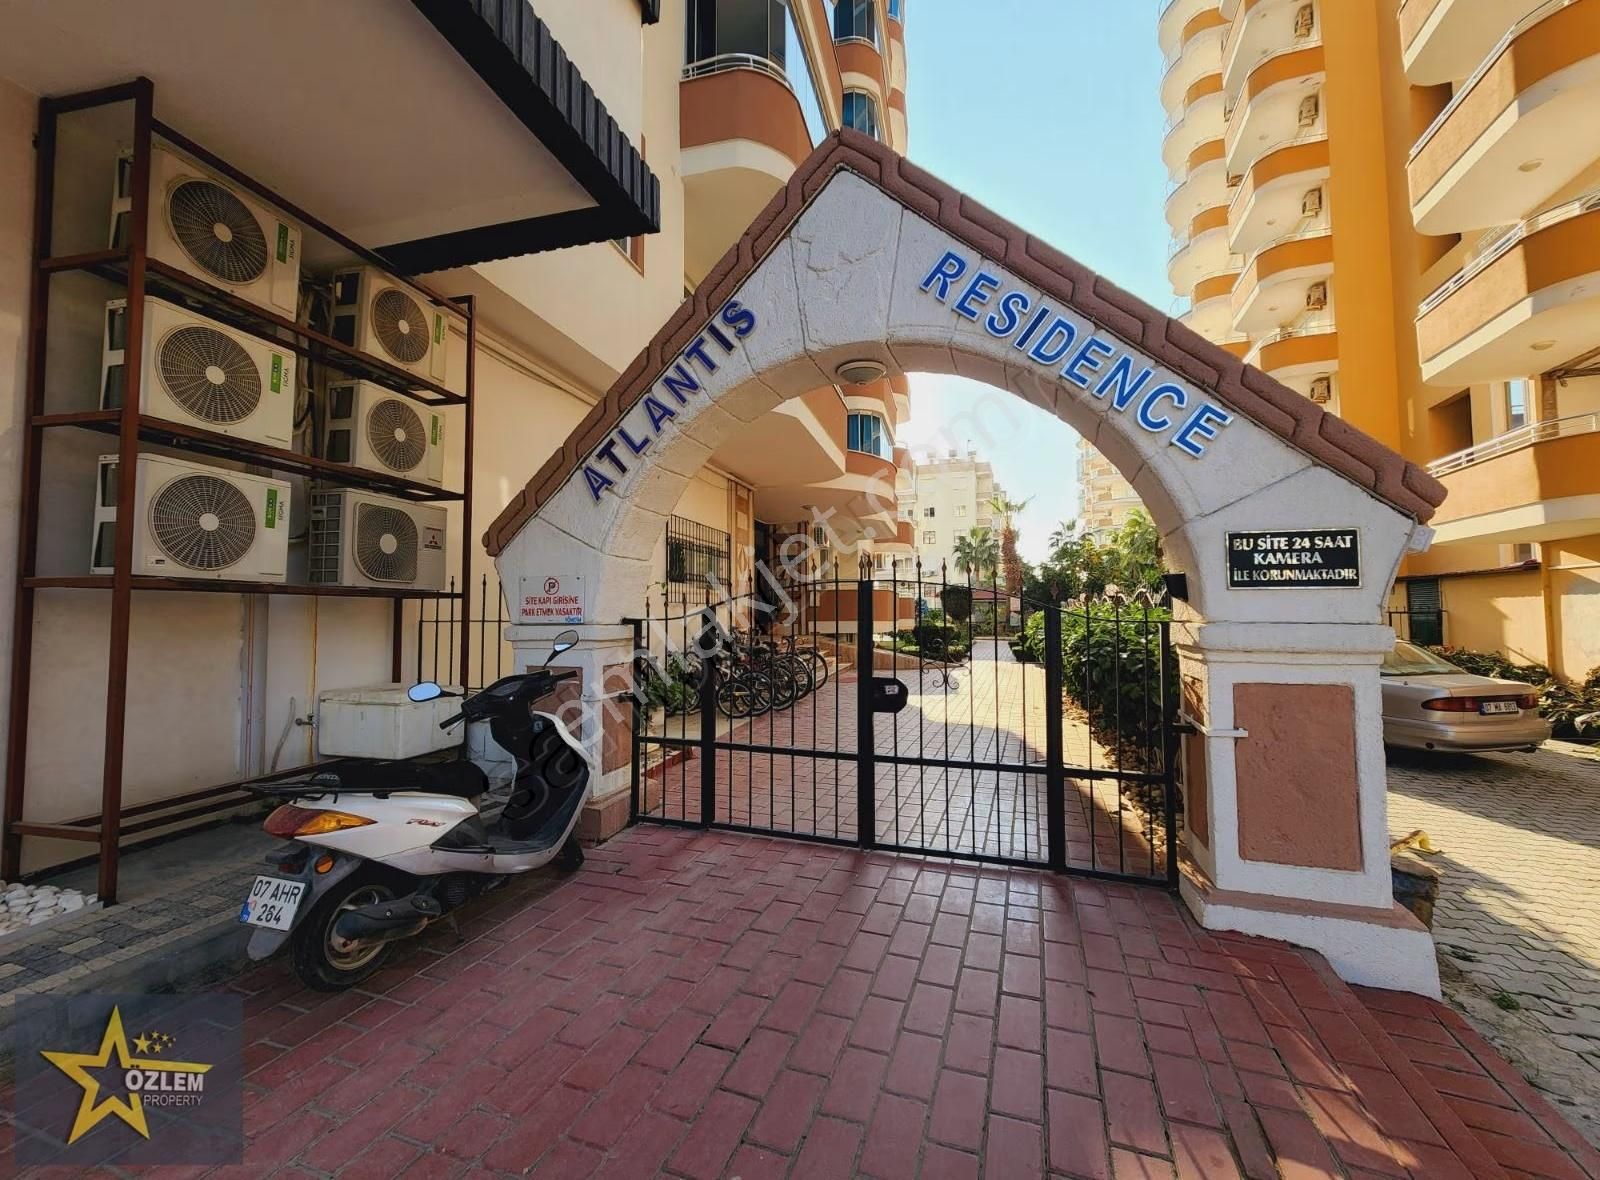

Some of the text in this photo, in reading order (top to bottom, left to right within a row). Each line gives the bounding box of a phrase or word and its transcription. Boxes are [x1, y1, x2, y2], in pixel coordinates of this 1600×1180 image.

[920, 250, 1233, 457] RESIDENCE
[581, 298, 757, 503] ATLANTIS
[1233, 535, 1354, 551] BU SİTE 24 SAAT
[1253, 551, 1324, 565] KAMERA
[1233, 567, 1358, 581] İLE KORUNMAKTADIR
[539, 596, 552, 605] KAPI
[521, 607, 535, 617] PARK
[536, 607, 554, 617] ETMEK
[253, 879, 301, 905] 07 AHR
[256, 903, 283, 925] 264
